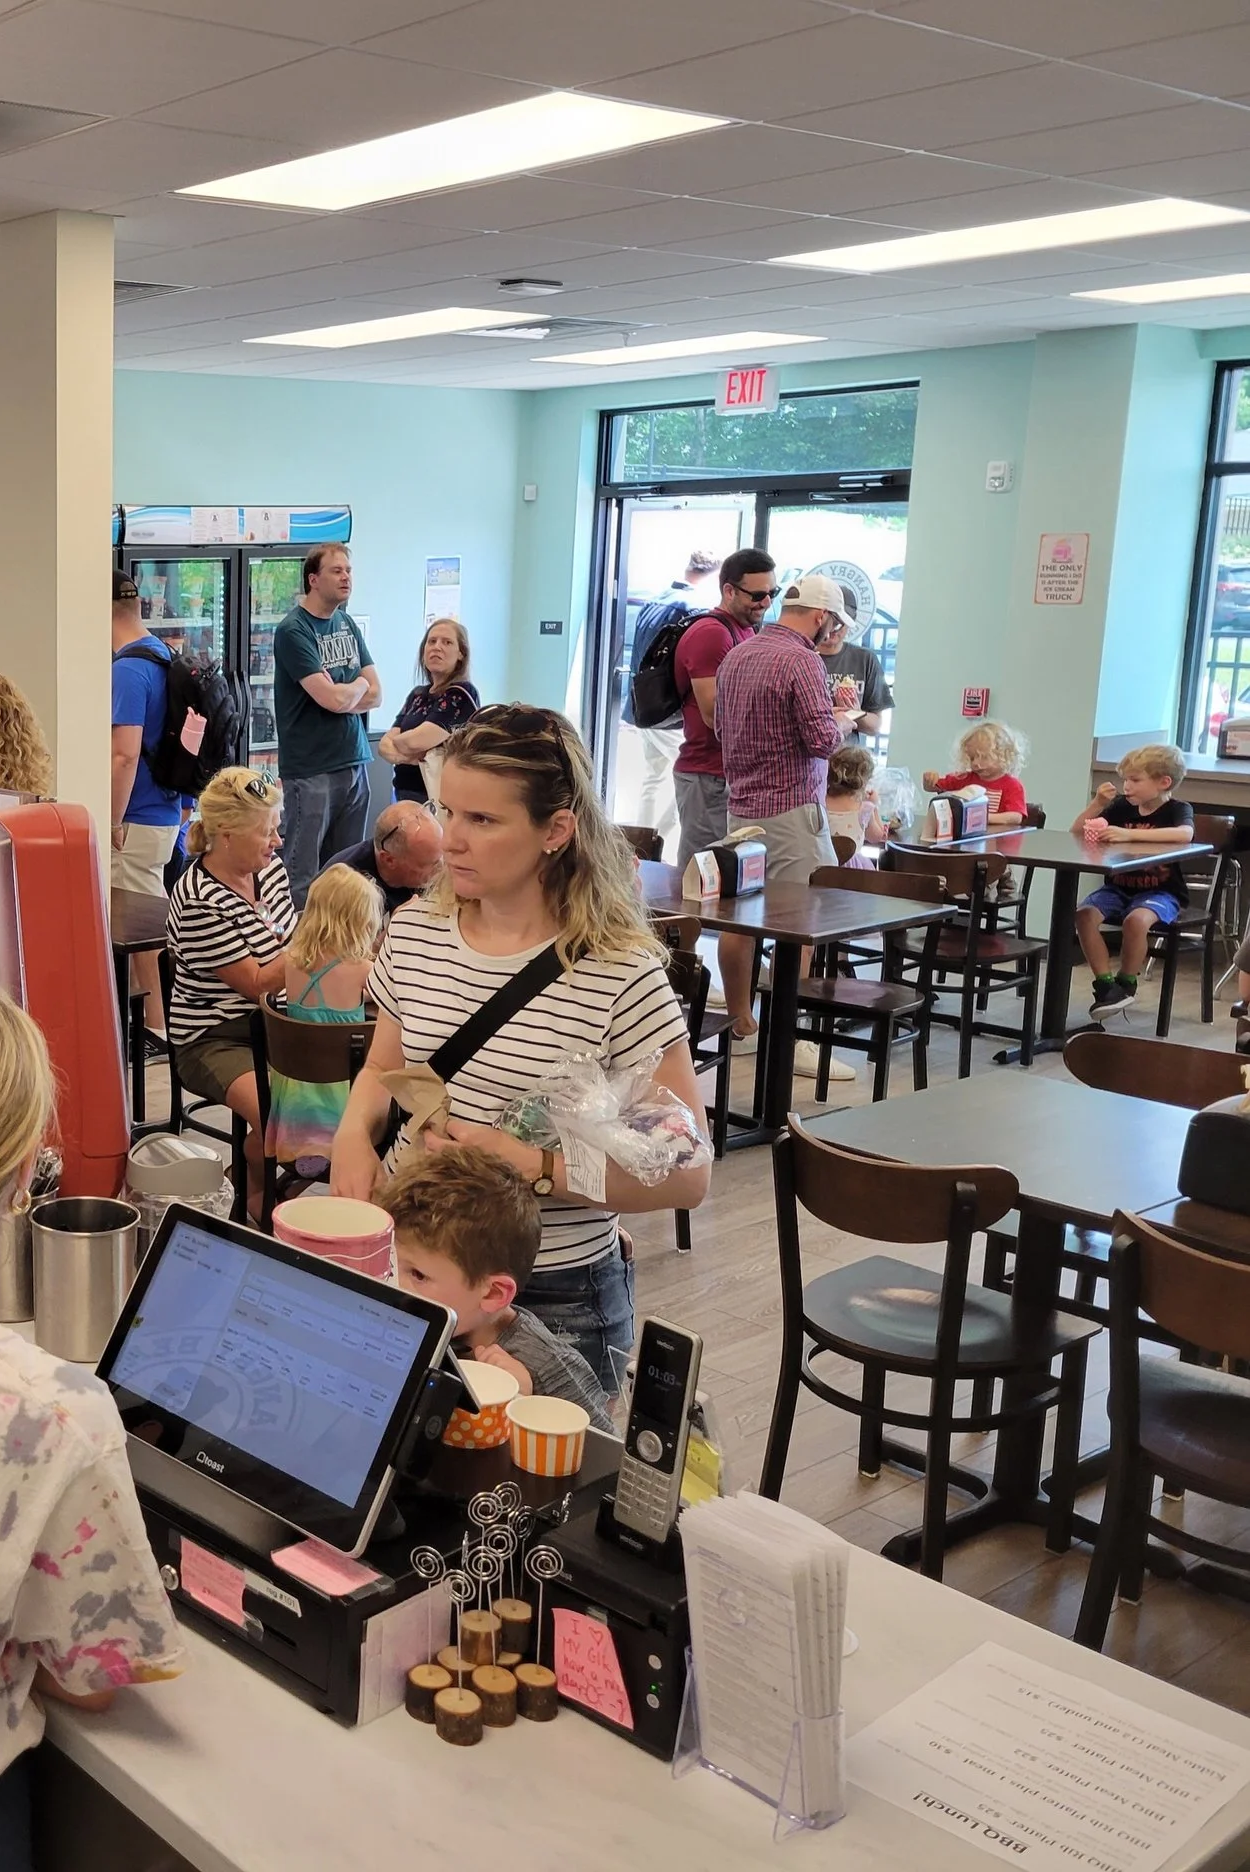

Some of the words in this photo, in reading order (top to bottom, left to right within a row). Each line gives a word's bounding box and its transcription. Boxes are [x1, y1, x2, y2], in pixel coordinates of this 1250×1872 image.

[726, 369, 767, 405] EXIT
[1041, 564, 1058, 572] THE
[1059, 564, 1083, 572] ONLY
[1045, 593, 1073, 601] TRUCK
[648, 1364, 676, 1386] 01:03
[204, 1455, 225, 1473] toast
[571, 1619, 581, 1636] I
[1047, 1701, 1092, 1722] under)
[1093, 1719, 1121, 1735] and
[1071, 1743, 1117, 1766] Platter
[1146, 1742, 1181, 1761] Meal
[962, 1757, 997, 1776] meat
[1046, 1763, 1091, 1788] Platter
[1119, 1763, 1154, 1783] Meat
[1184, 1759, 1227, 1783] Kiddo
[1009, 1779, 1040, 1797] plus
[1094, 1785, 1129, 1805] Meat
[1156, 1780, 1191, 1798] BBQ
[913, 1791, 980, 1830] Lunch!
[977, 1803, 1001, 1818] $25
[1042, 1795, 1087, 1820] Platter
[1132, 1802, 1167, 1822] BBQ
[1090, 1818, 1115, 1832] Rib
[982, 1825, 1028, 1854] BBQ
[1118, 1830, 1152, 1850] BBQ
[1060, 1844, 1086, 1860] Rib
